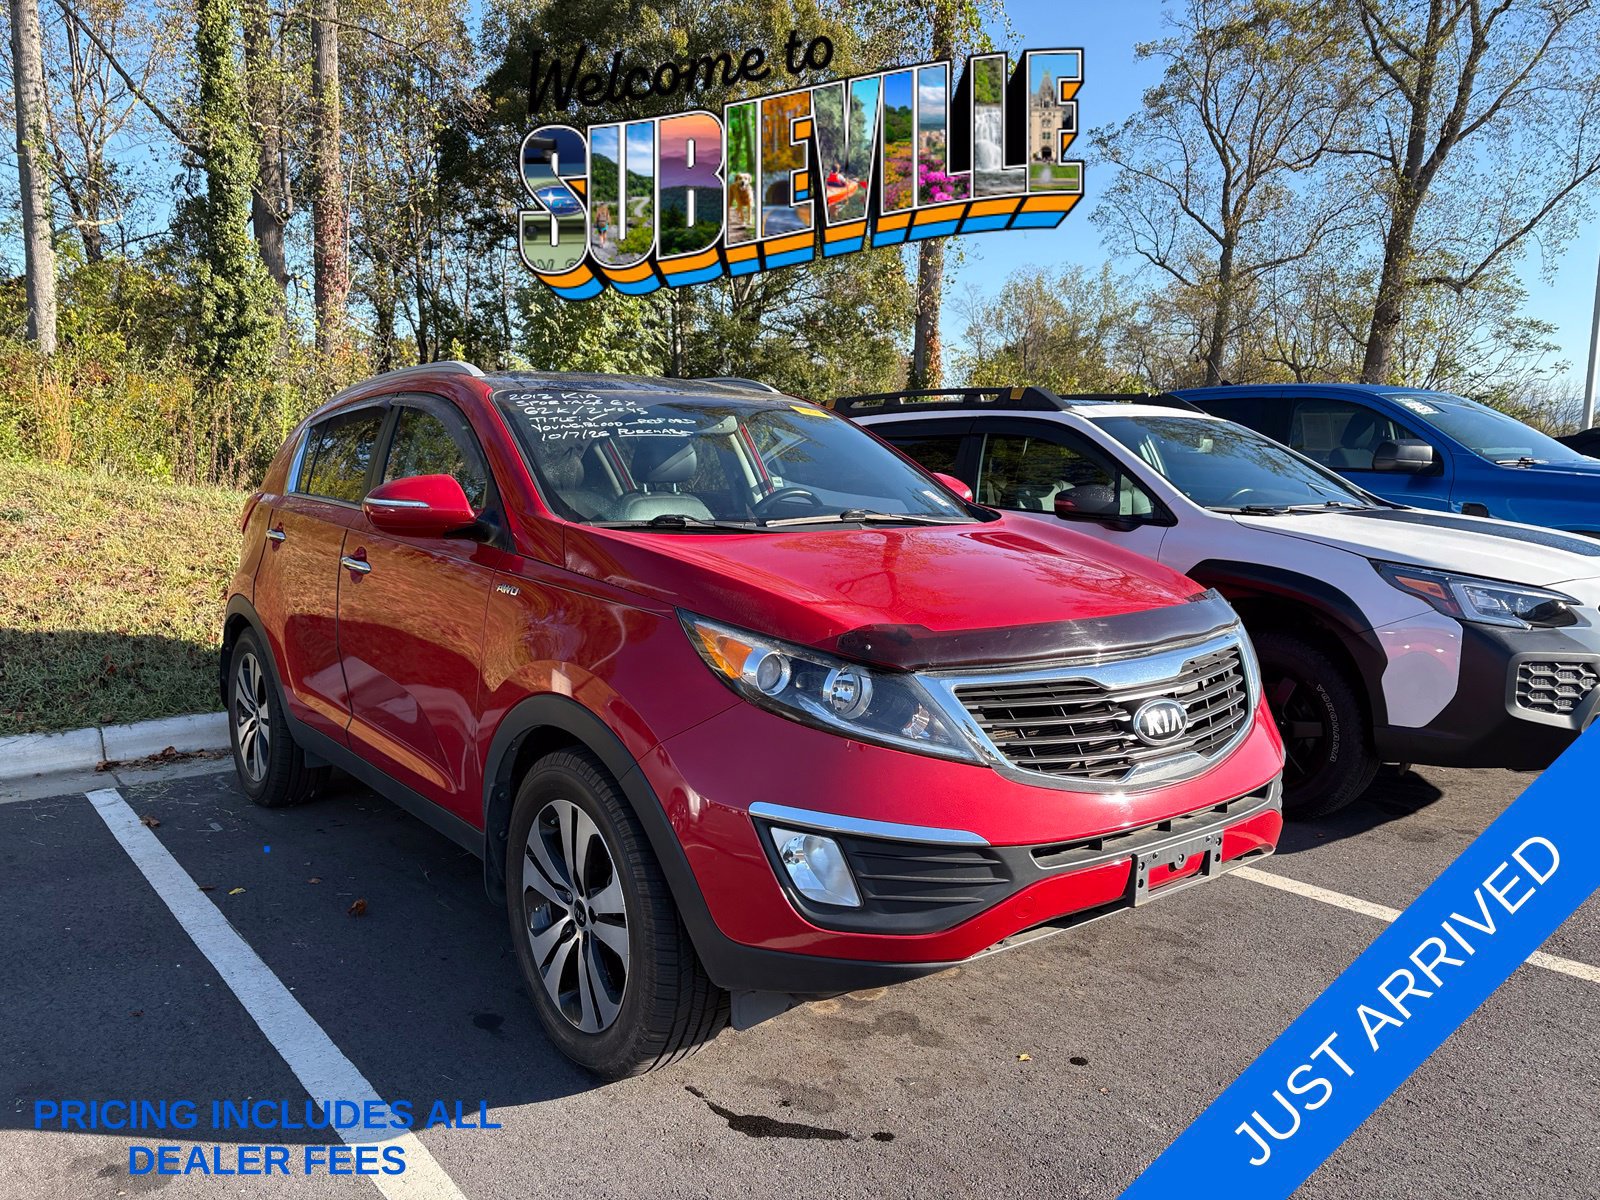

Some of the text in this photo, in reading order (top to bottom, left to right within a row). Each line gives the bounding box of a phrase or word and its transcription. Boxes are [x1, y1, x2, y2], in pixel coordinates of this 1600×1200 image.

[496, 584, 520, 596] AWD
[1144, 707, 1183, 737] KIA
[1316, 684, 1340, 763] YOKOHAMA
